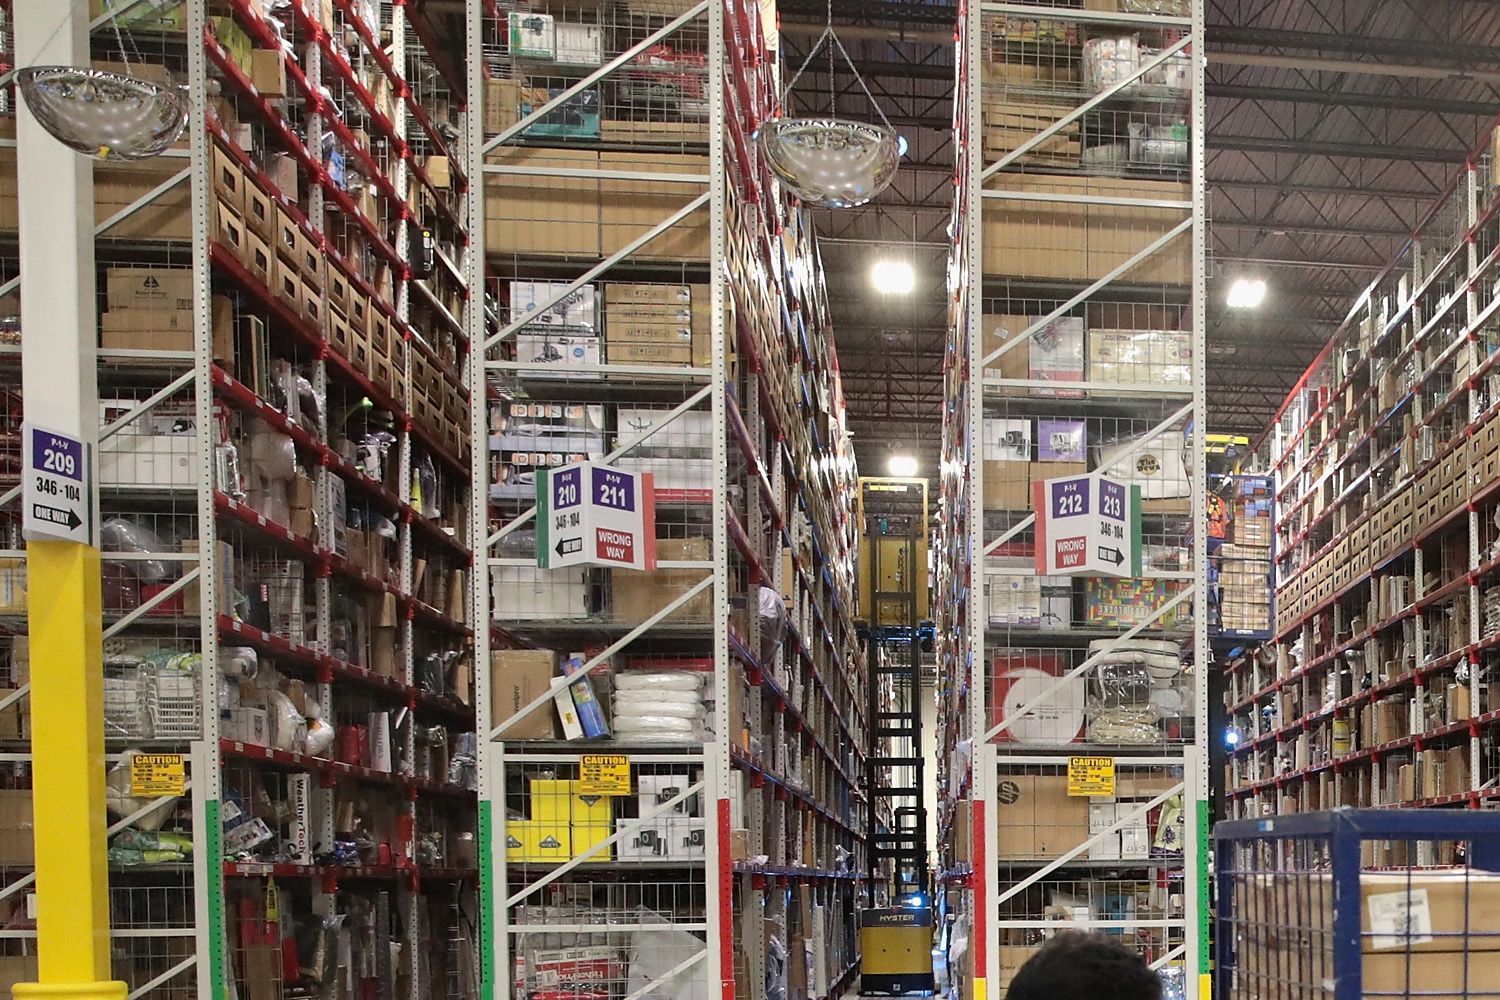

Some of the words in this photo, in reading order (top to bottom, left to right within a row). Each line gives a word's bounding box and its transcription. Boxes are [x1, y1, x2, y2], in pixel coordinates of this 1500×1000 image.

[51, 438, 68, 450] P-1-V
[43, 449, 75, 475] 209
[606, 474, 621, 484] P-1-V
[558, 484, 576, 506] 210
[1064, 484, 1078, 493] P-1-V
[600, 484, 626, 507] 211
[1059, 494, 1083, 515] 212
[1103, 495, 1120, 517] 213
[35, 507, 51, 520] ONE
[52, 510, 69, 524] WAY
[598, 531, 632, 546] WRONG
[606, 546, 625, 559] WAY
[1057, 539, 1085, 553] WRONG
[1062, 554, 1079, 565] WAY
[135, 755, 179, 764] CAUTION
[584, 756, 626, 765] CAUTION
[1072, 758, 1111, 766] CAUTION
[296, 779, 306, 854] WeatherTech
[1126, 844, 1146, 852] E-117
[558, 970, 604, 981] Fisher-Pric
